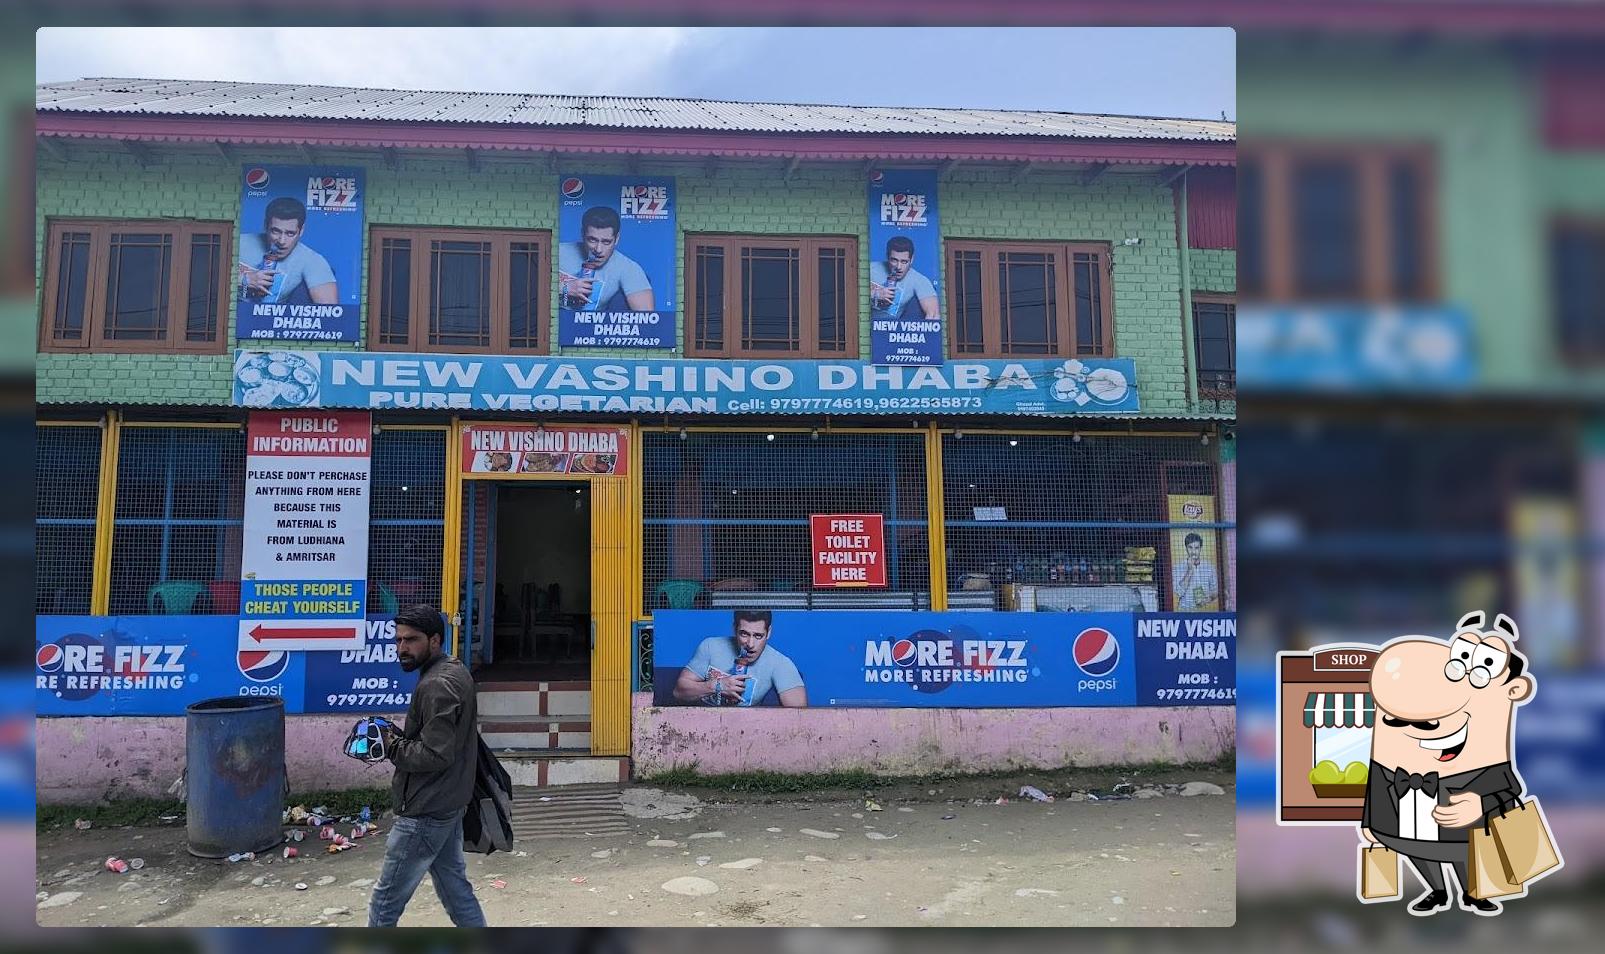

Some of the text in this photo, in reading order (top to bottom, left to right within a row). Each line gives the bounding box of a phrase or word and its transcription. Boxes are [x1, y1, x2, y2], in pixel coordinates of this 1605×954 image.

[308, 177, 356, 190] MORE
[307, 190, 356, 206] FIZZ
[621, 186, 666, 198] MORE
[882, 194, 926, 206] MORE
[620, 198, 668, 215] FIZZ
[880, 206, 927, 222] FIZZ
[253, 304, 343, 318] NEW VISHNO
[273, 317, 322, 329] DHABA
[574, 312, 660, 324] NEW VISHNO
[594, 324, 640, 336] DHABA
[873, 321, 940, 332] NEW VISHNO
[251, 330, 274, 338] MOB
[282, 331, 342, 340] 9797774619
[889, 333, 926, 343] DHABA
[604, 338, 660, 346] 9797774619
[332, 360, 1037, 392] NEW VASHINO DHABA
[369, 391, 472, 408] PURE
[481, 393, 716, 412] VEGETARIAN
[728, 399, 764, 410] Cell:
[280, 418, 338, 433] PUBLIC
[254, 437, 366, 452] INFORMATION
[471, 430, 618, 452] NEW VISHNO DHABA
[248, 471, 367, 480] PLEASE DON'T PERCHASE
[255, 487, 362, 496] ANYTHING FROM HERE
[274, 504, 340, 512] BECAUSE THIS
[277, 520, 336, 528] MATERIAL IS
[830, 520, 864, 532] FREE
[267, 536, 345, 544] FROM LUDHIANA
[825, 536, 870, 548] TOILET
[276, 553, 336, 562] & AMRITSAR
[819, 552, 876, 564] FACILITY
[832, 568, 866, 580] HERE
[255, 584, 352, 596] THOSE PEOPLE
[245, 601, 360, 614] CHEAT YOURSELF
[366, 620, 396, 640] VIS
[1138, 619, 1236, 638] NEW VISHN
[340, 644, 400, 664] DHAB
[865, 640, 1028, 666] MORE FIZZ
[1166, 642, 1228, 660] DHABA
[36, 644, 186, 672] ORE FIZZ
[865, 670, 1028, 682] MORE REFRESHING
[1178, 674, 1210, 684] MOB
[36, 676, 184, 690] RE REFRESHING
[352, 678, 389, 689] MOB
[1078, 678, 1116, 692] pepsi
[239, 683, 282, 696] pepsi
[326, 694, 412, 706] 979777461
